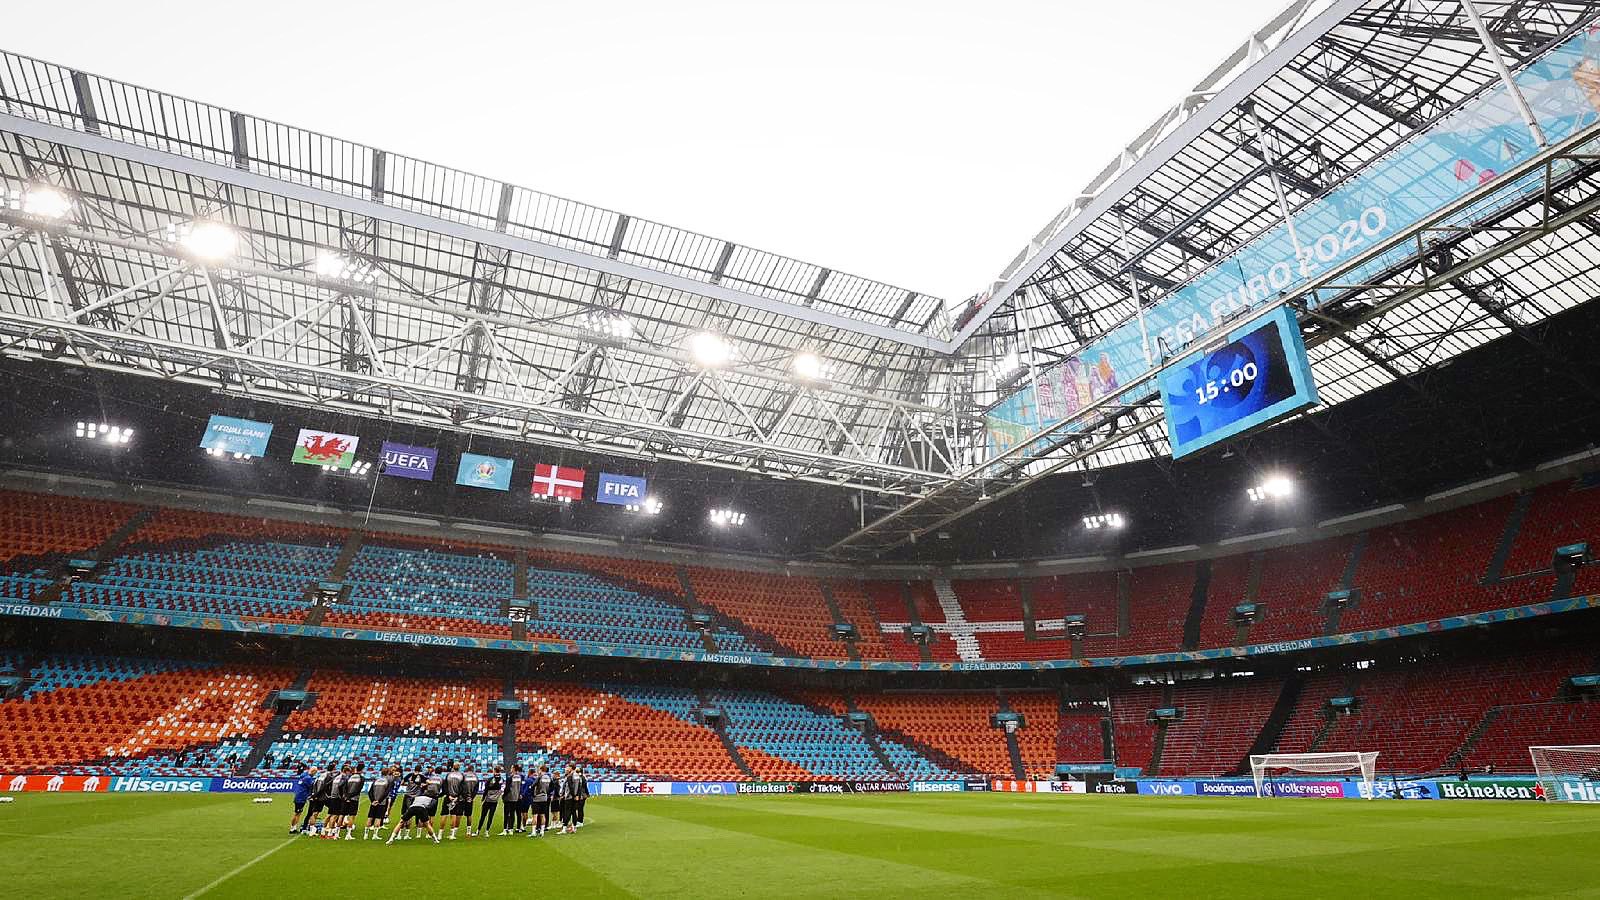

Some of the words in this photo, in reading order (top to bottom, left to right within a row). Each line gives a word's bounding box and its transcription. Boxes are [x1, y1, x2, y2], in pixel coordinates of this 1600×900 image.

[1297, 206, 1387, 279] 2020
[1196, 362, 1258, 405] 15:00
[385, 452, 429, 470] UEFA
[605, 481, 640, 498] FIFA
[375, 632, 402, 642] UEFA
[404, 634, 431, 644] EURO
[432, 636, 458, 646] 2020
[1254, 640, 1313, 655] AMSTERDAM
[701, 654, 751, 664] AMSTERDAM
[960, 662, 979, 671] UEFA
[980, 662, 1000, 670] EURO
[1002, 662, 1021, 670] 2020
[114, 777, 202, 792] Hisense
[223, 779, 293, 790] Booking.com
[624, 783, 654, 793] FedEx
[687, 783, 722, 794] vivo
[739, 783, 785, 793] Heineken
[818, 784, 843, 793] TikTok
[855, 783, 879, 791] QATAR
[881, 783, 910, 791] AIRWAYS
[913, 781, 960, 792] Hisense
[1051, 782, 1073, 792] FedEx
[1103, 784, 1126, 793] TikTok
[1150, 783, 1182, 795] vivo
[1203, 783, 1254, 795] Booking.com
[1278, 783, 1340, 797] Volkswagen
[1441, 783, 1532, 799] Heineken
